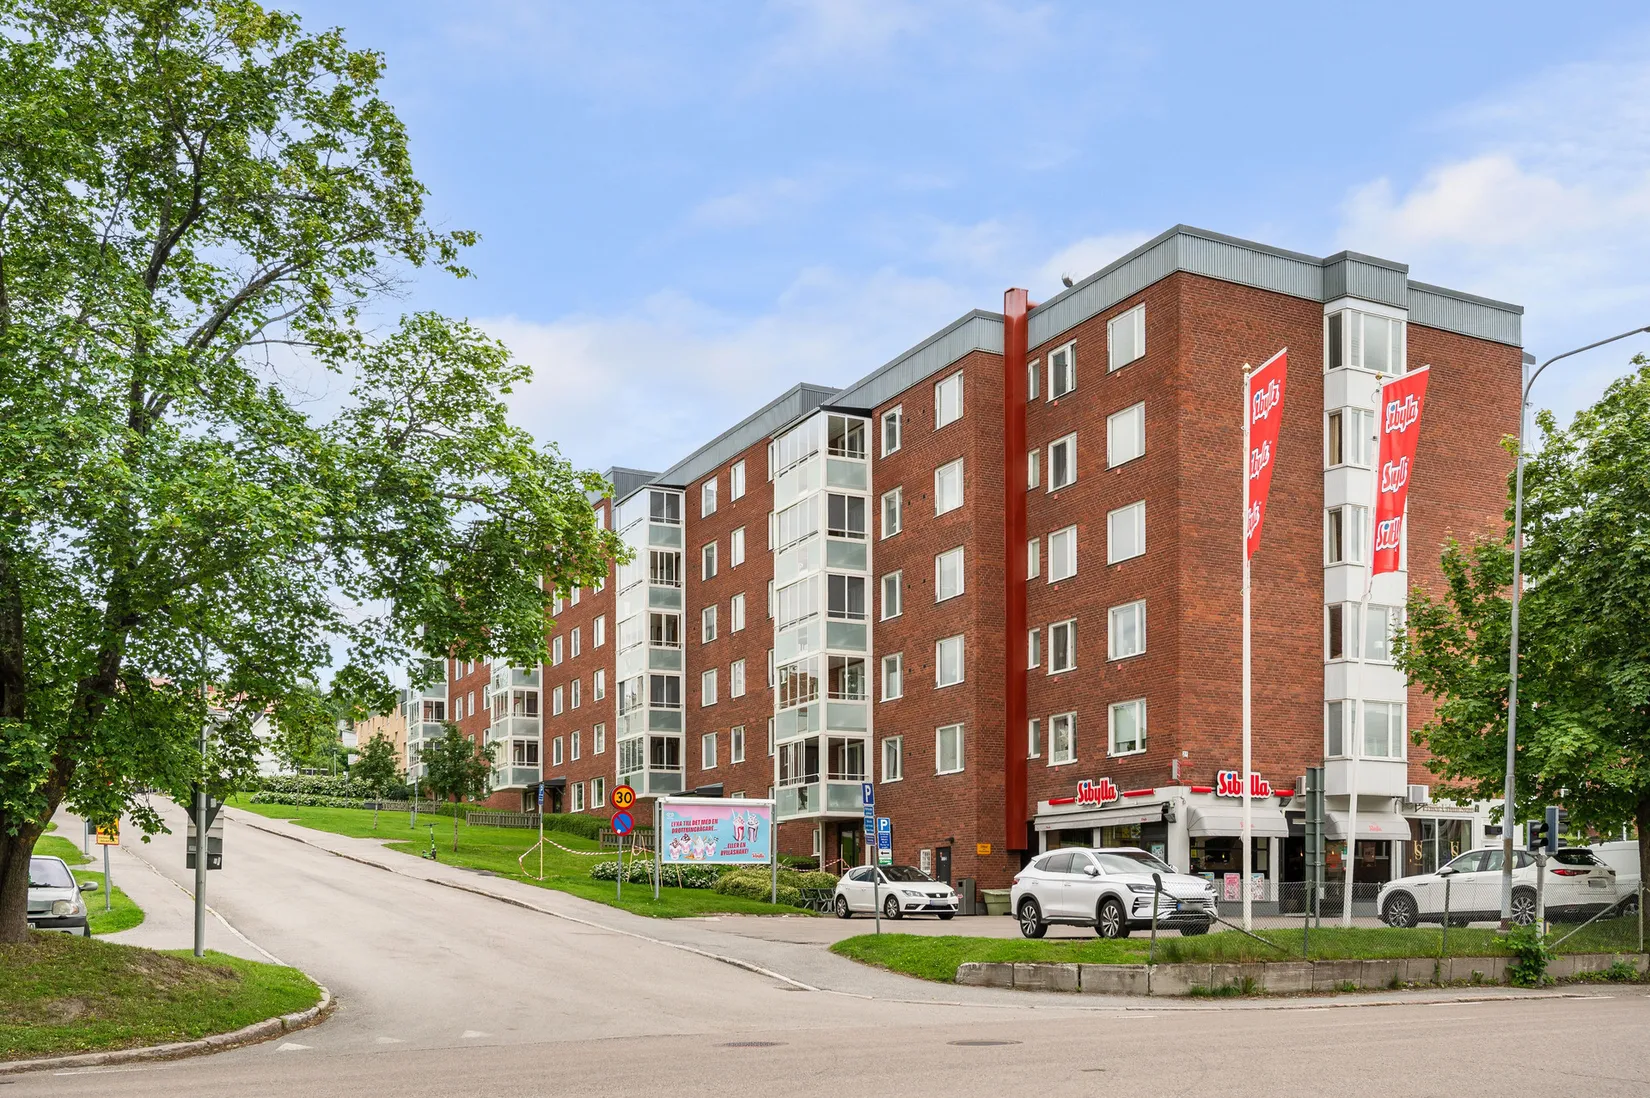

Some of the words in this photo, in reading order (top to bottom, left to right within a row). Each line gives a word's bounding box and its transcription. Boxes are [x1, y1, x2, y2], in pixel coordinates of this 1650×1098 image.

[1077, 777, 1118, 807] Sibylla
[1216, 770, 1271, 798] Siblla
[616, 791, 632, 804] 30
[880, 820, 888, 831] P
